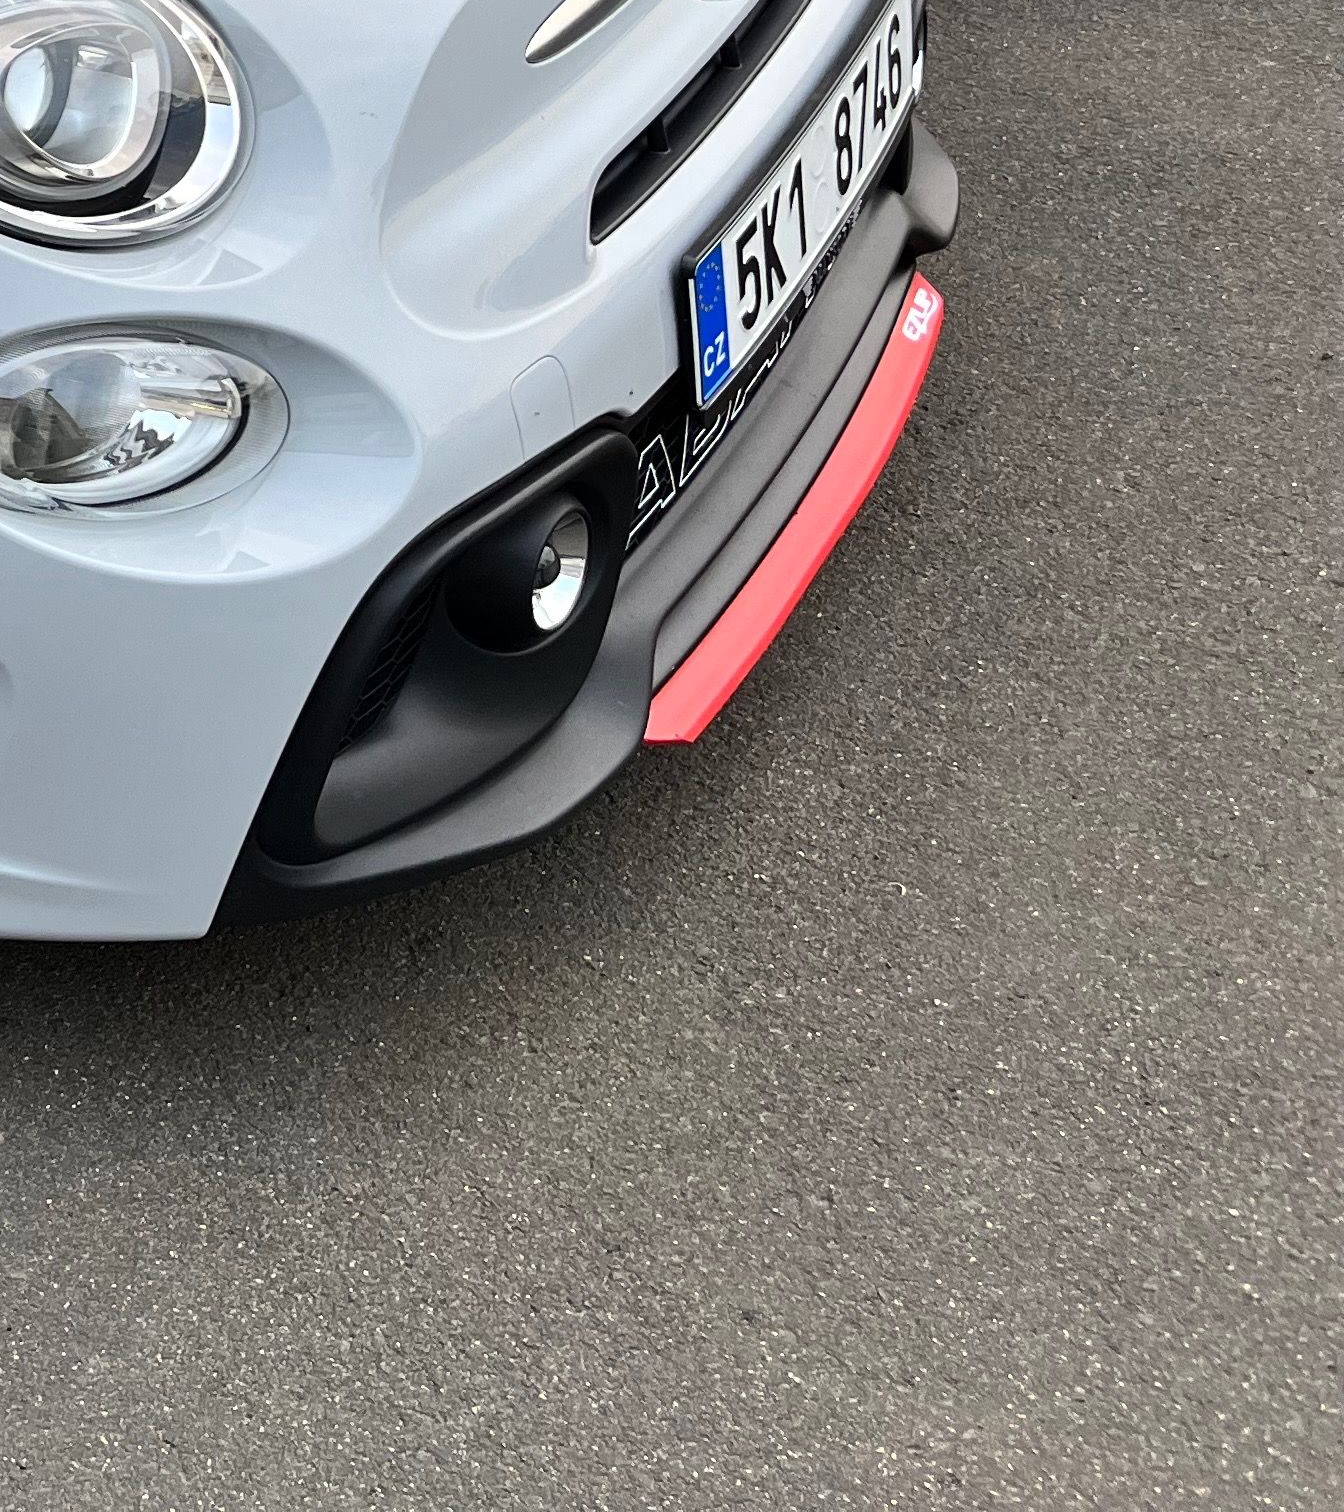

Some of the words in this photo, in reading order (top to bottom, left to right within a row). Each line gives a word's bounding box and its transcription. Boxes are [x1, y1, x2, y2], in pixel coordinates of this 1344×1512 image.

[735, 158, 807, 330] 5K1
[834, 13, 901, 196] 8746
[703, 330, 725, 377] CZ
